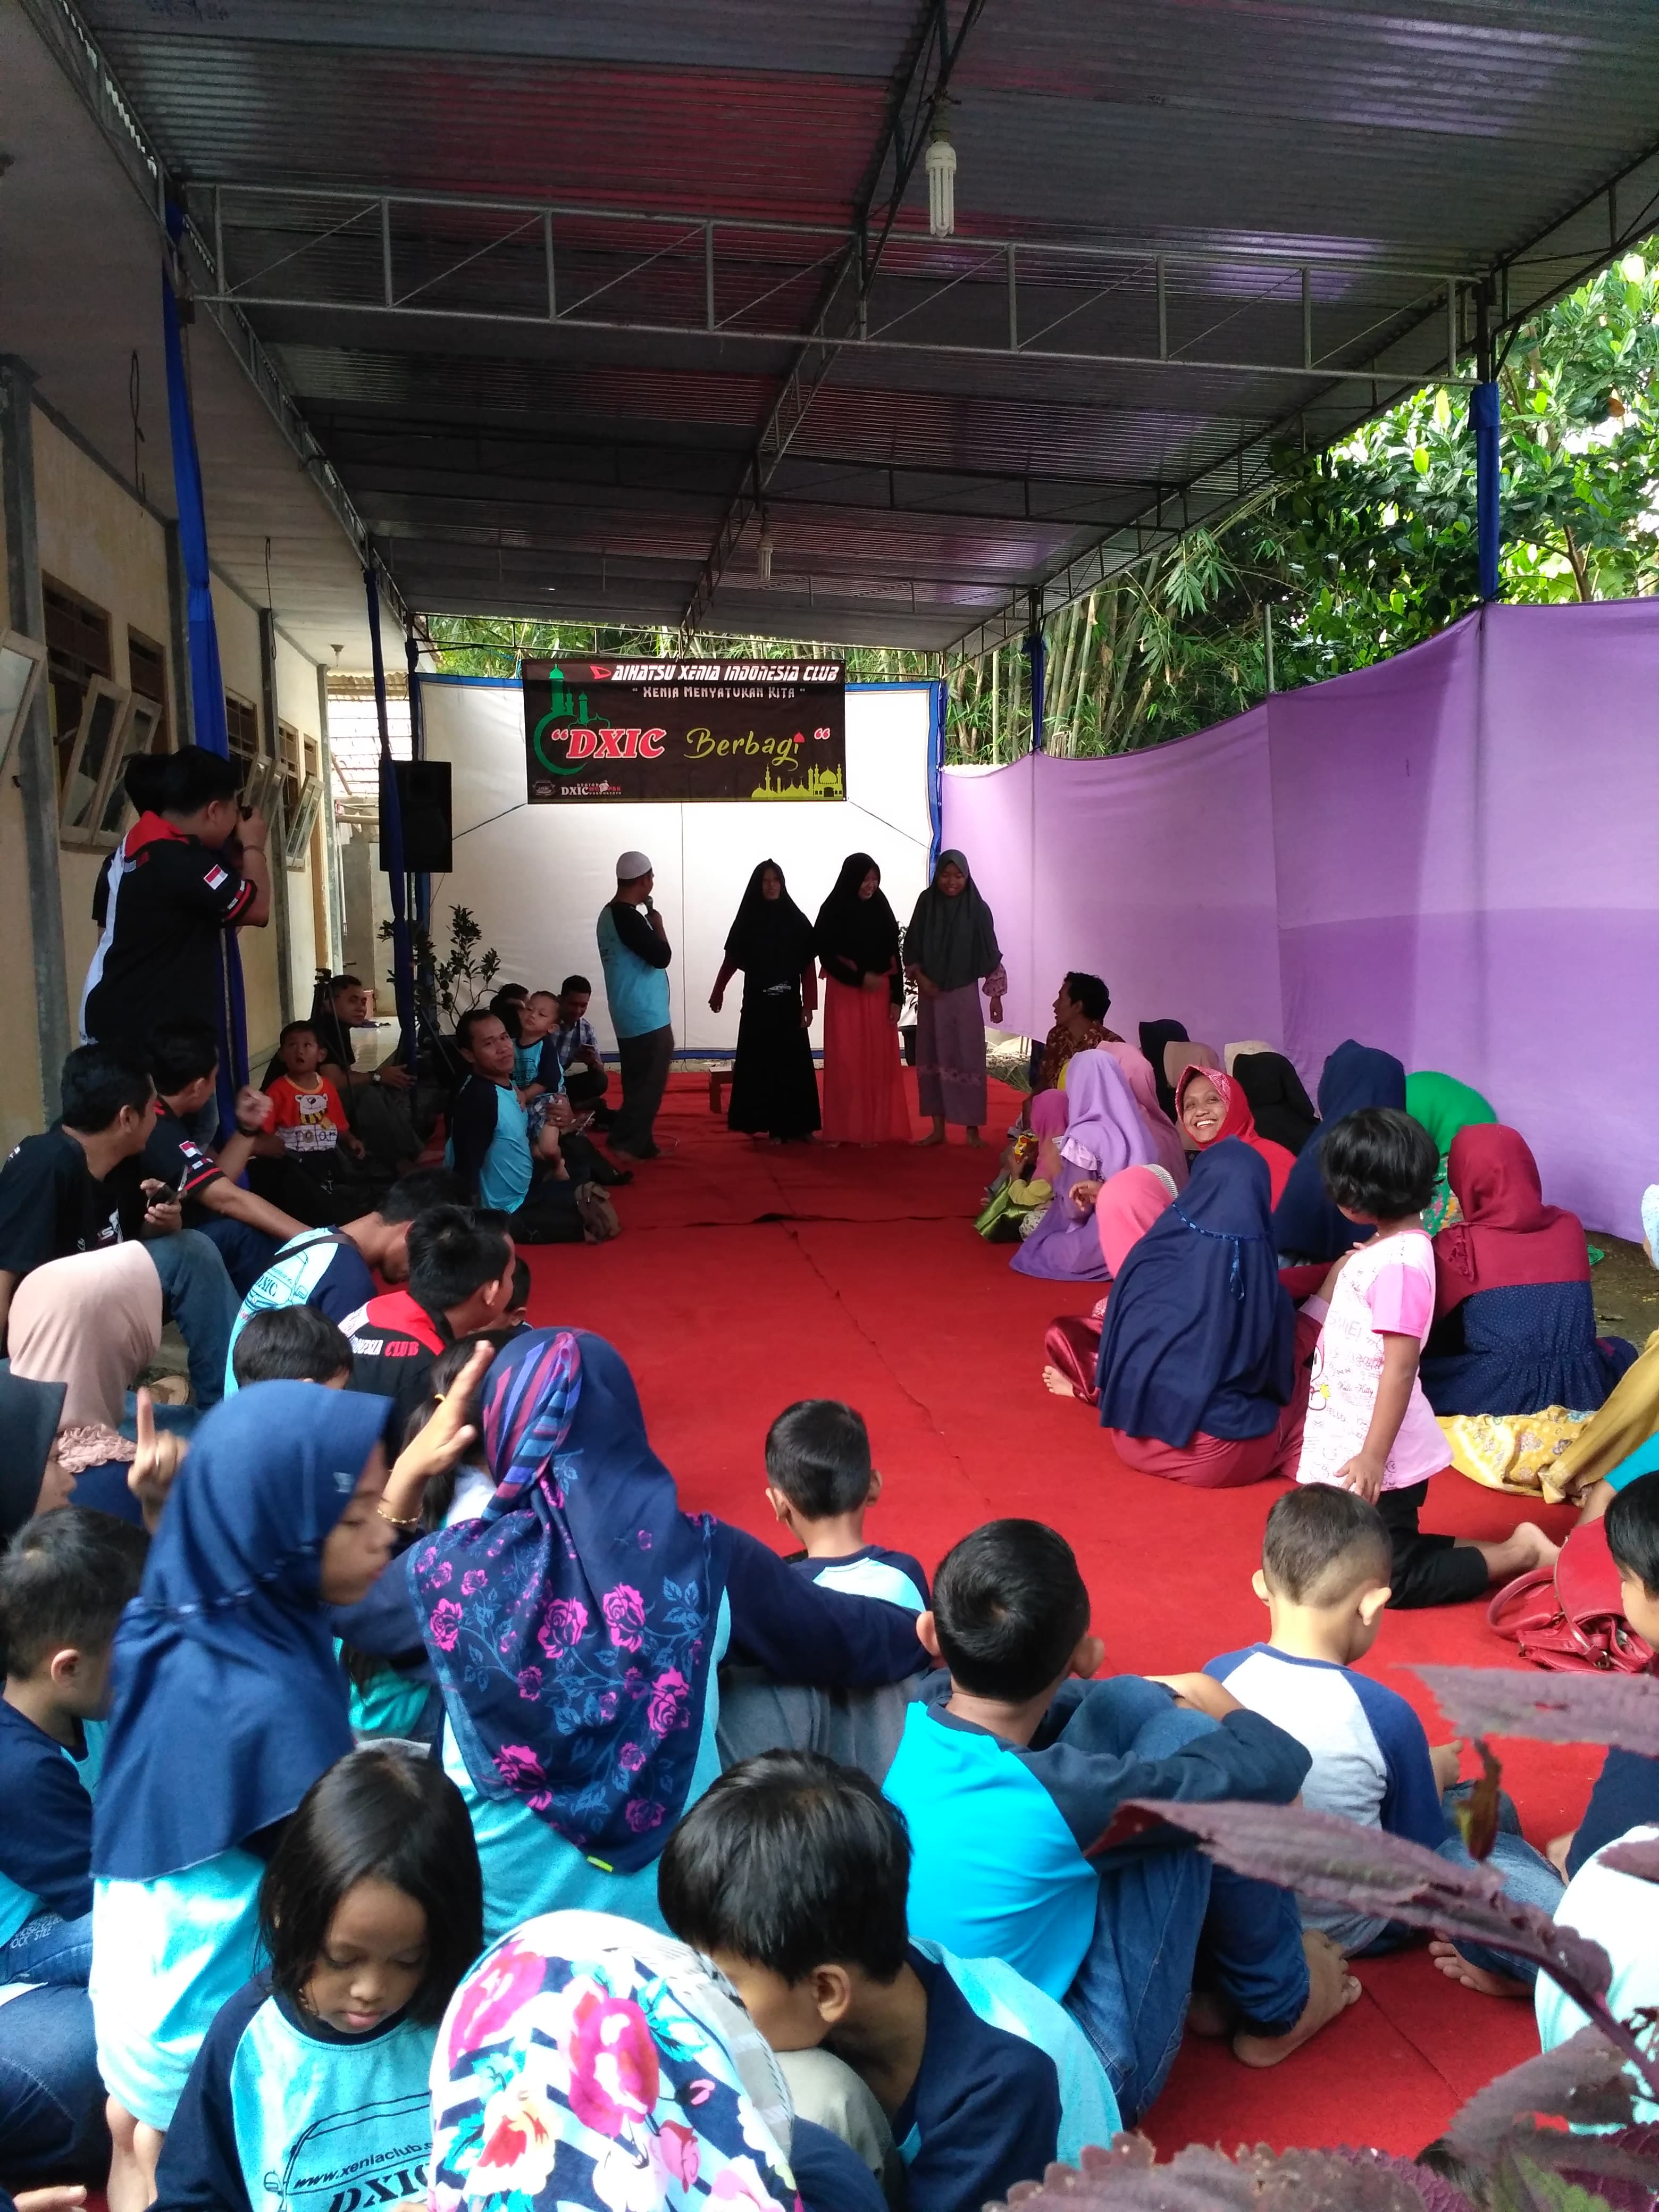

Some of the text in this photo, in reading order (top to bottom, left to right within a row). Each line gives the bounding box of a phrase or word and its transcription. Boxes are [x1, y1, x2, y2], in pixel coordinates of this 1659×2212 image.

[677, 665, 721, 681] XENIA
[724, 665, 800, 681] INDONESIA
[803, 666, 840, 682] CLUB
[643, 686, 679, 699] XENIA
[684, 686, 764, 699] MENYATUKAN
[768, 686, 795, 699] KITA
[684, 727, 805, 772] Berbagi
[561, 786, 589, 795] DXIC
[384, 1341, 419, 1356] CLUB
[1355, 1384, 1374, 1397] Kitty
